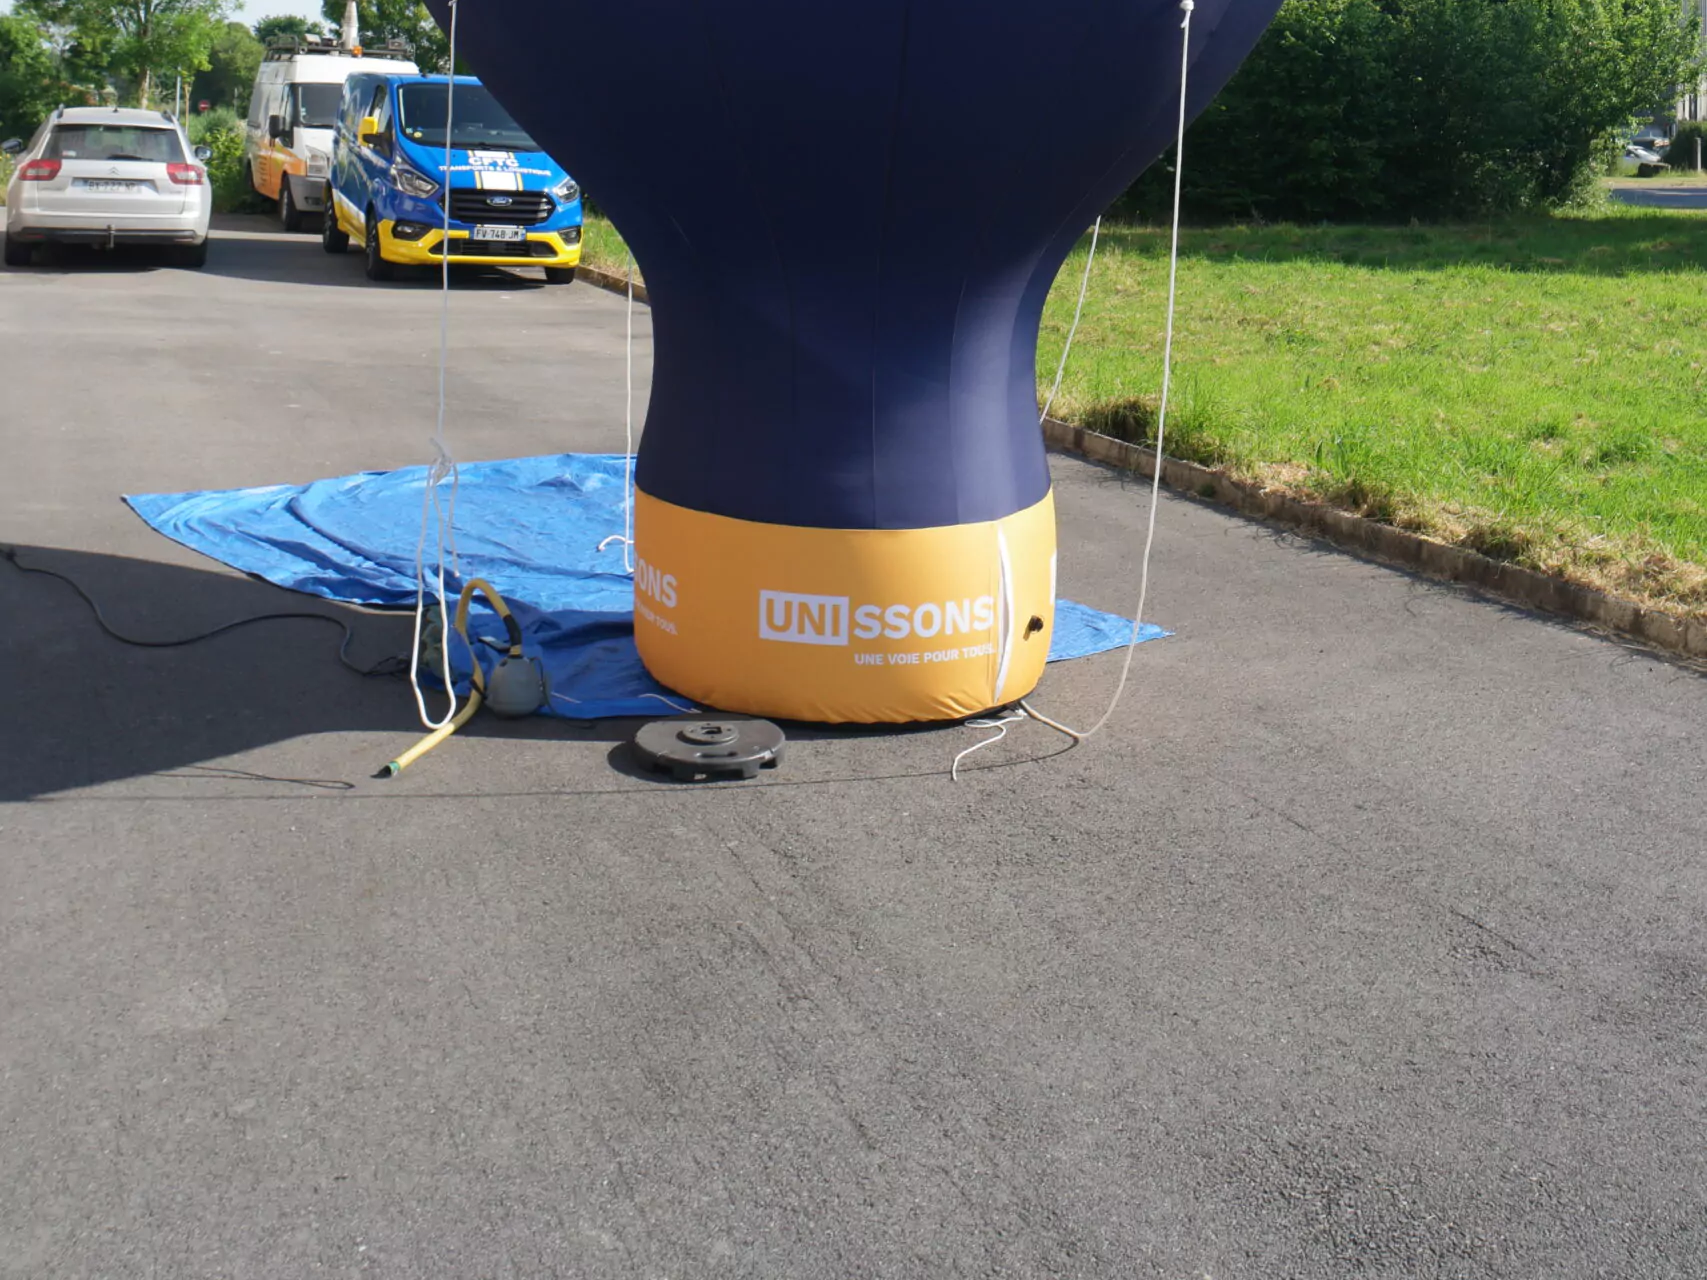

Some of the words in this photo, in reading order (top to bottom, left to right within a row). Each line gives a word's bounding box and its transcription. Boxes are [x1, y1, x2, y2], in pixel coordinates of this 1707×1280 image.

[468, 156, 519, 168] CFTC
[759, 590, 995, 646] UNISSONS
[854, 653, 883, 666] UNE
[888, 652, 920, 665] VOIE
[924, 648, 959, 663] POUR
